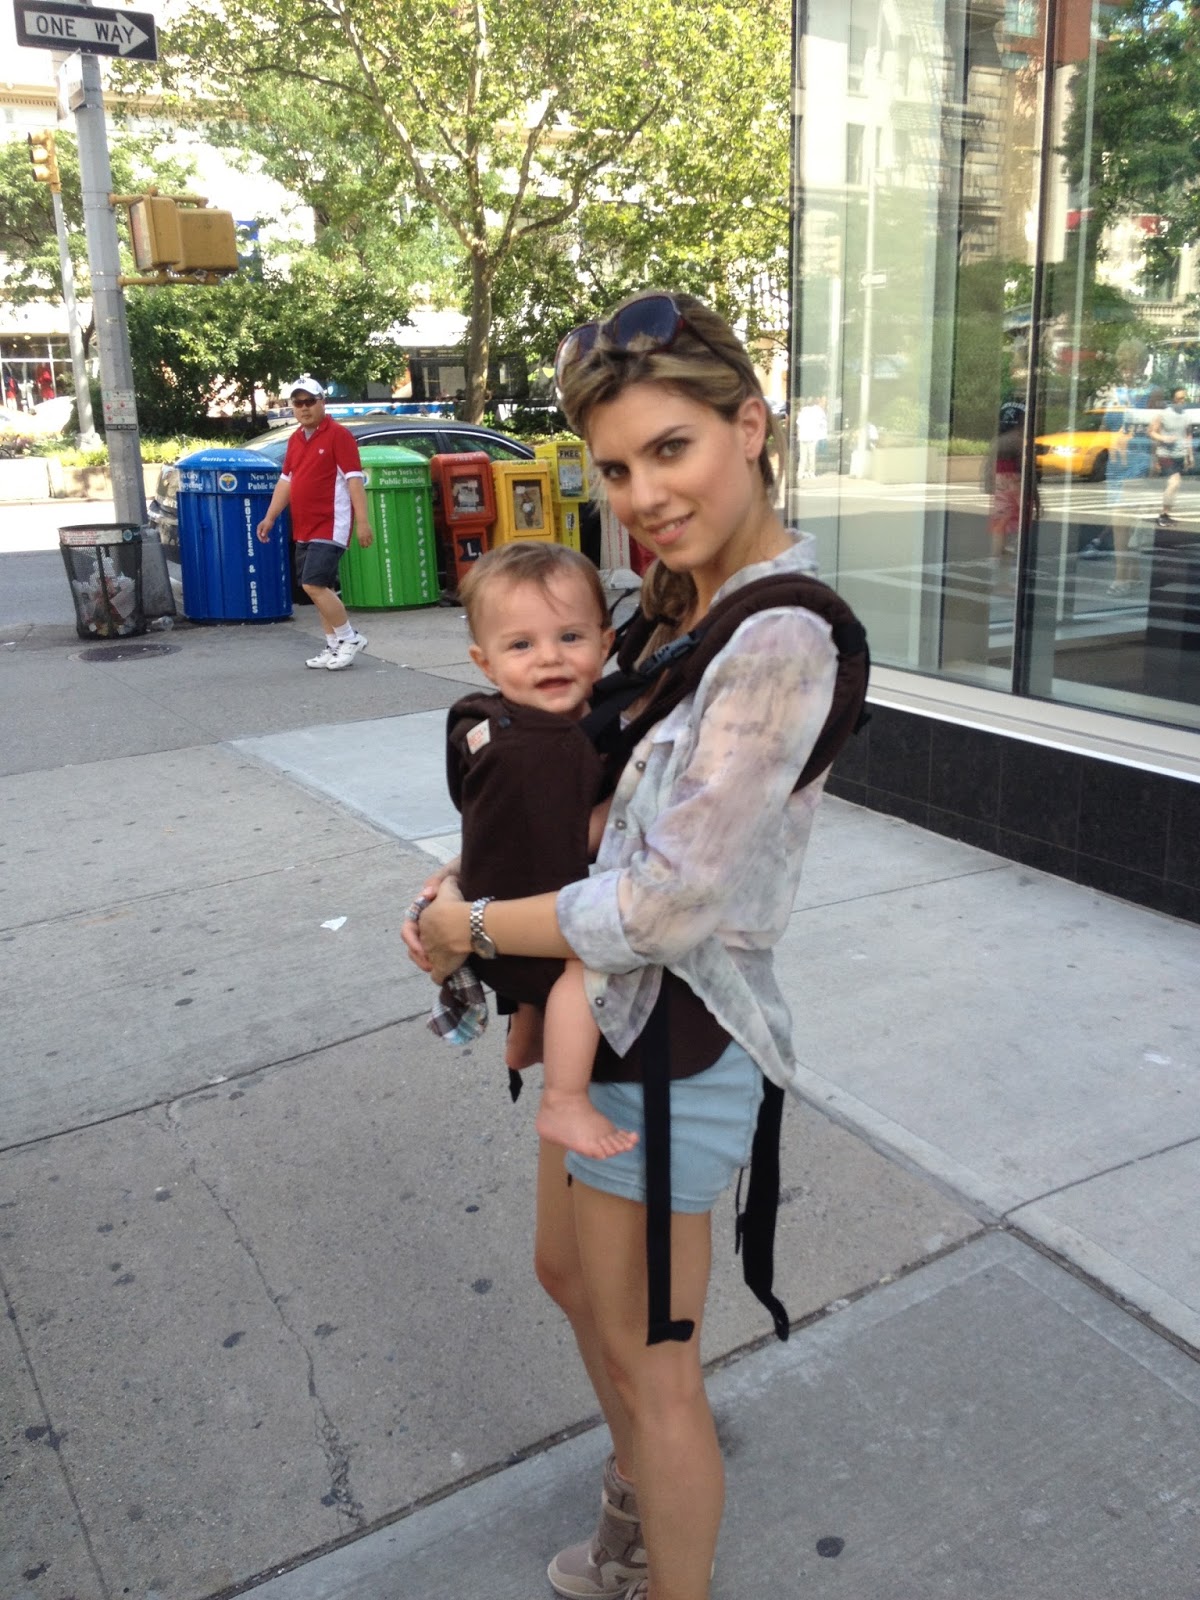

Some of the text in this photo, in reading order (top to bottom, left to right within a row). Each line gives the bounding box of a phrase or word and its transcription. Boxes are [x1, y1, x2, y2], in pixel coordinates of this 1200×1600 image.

[36, 15, 135, 44] ONE WAY
[559, 449, 579, 458] FREE
[399, 468, 412, 476] York
[248, 482, 267, 490] Public
[244, 498, 254, 557] BOTTLES
[249, 564, 256, 574] &
[250, 581, 258, 614] CANS
